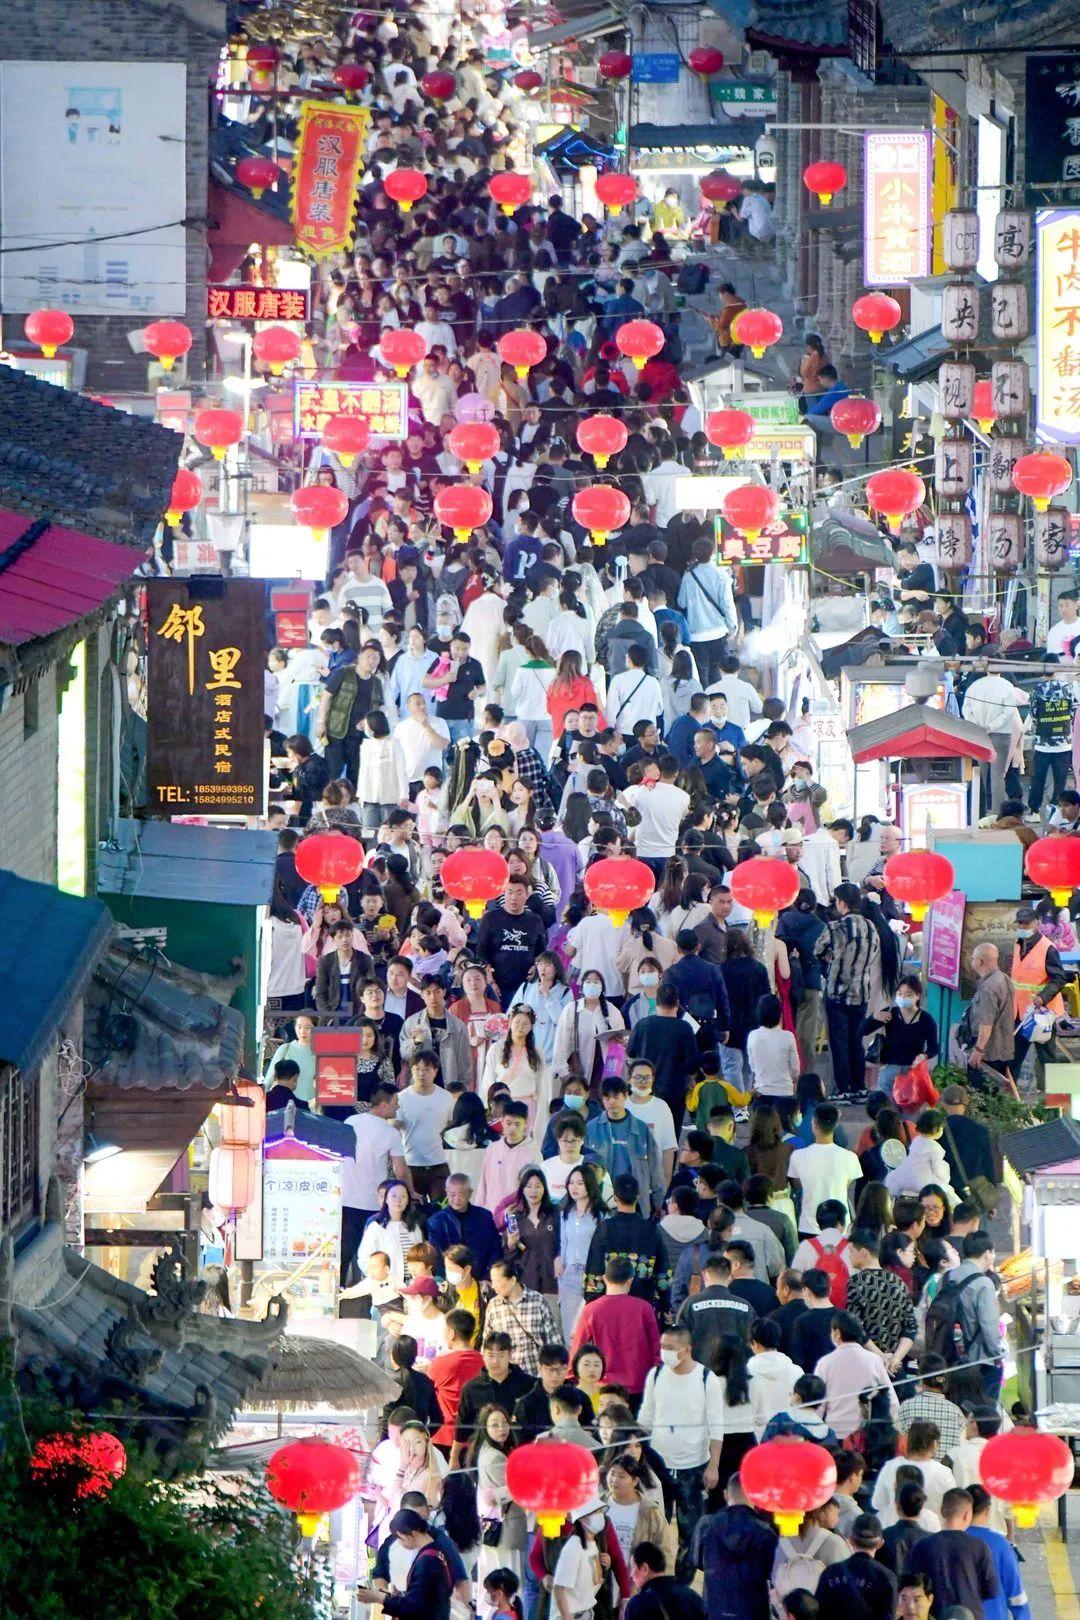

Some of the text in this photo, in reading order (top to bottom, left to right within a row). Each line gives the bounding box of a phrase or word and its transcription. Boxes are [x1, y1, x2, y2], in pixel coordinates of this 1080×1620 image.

[308, 135, 343, 222] 汉服唐装
[209, 288, 305, 319] 汉服唐装
[722, 535, 802, 560] 臭豆腐
[157, 603, 242, 696] 邻里
[214, 694, 232, 774] 酒店式民宿
[156, 784, 255, 803] TEL: 18539593950
